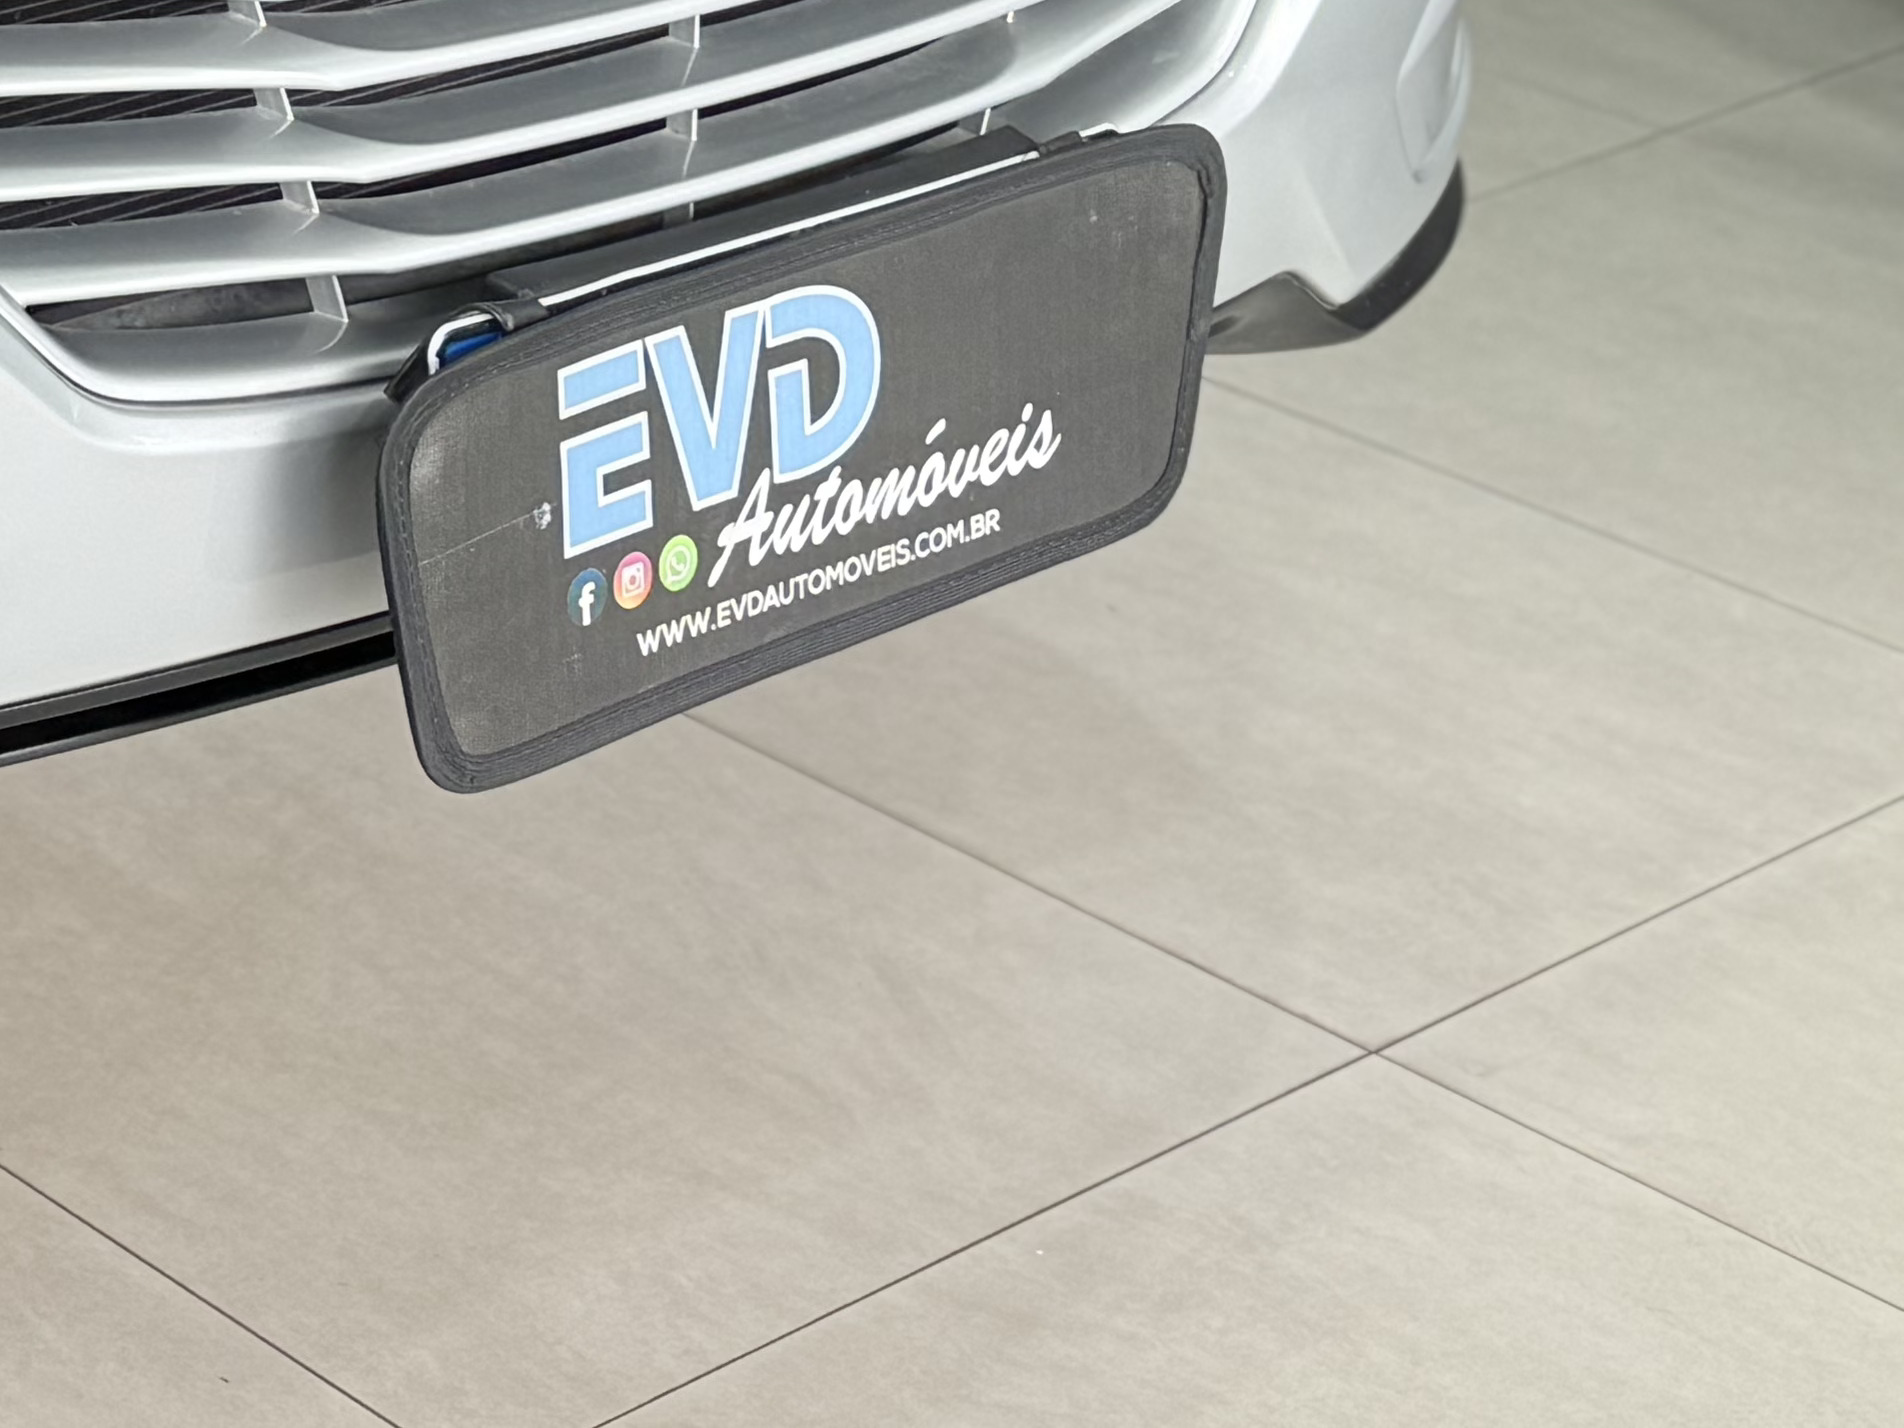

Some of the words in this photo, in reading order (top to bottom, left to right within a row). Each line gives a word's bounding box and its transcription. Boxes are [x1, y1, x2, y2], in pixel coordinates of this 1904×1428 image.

[558, 284, 881, 559] EVD
[707, 402, 1062, 588] Automóveis
[636, 508, 1001, 657] WWW.EVDAUTOMOVEIS.COM.BR
